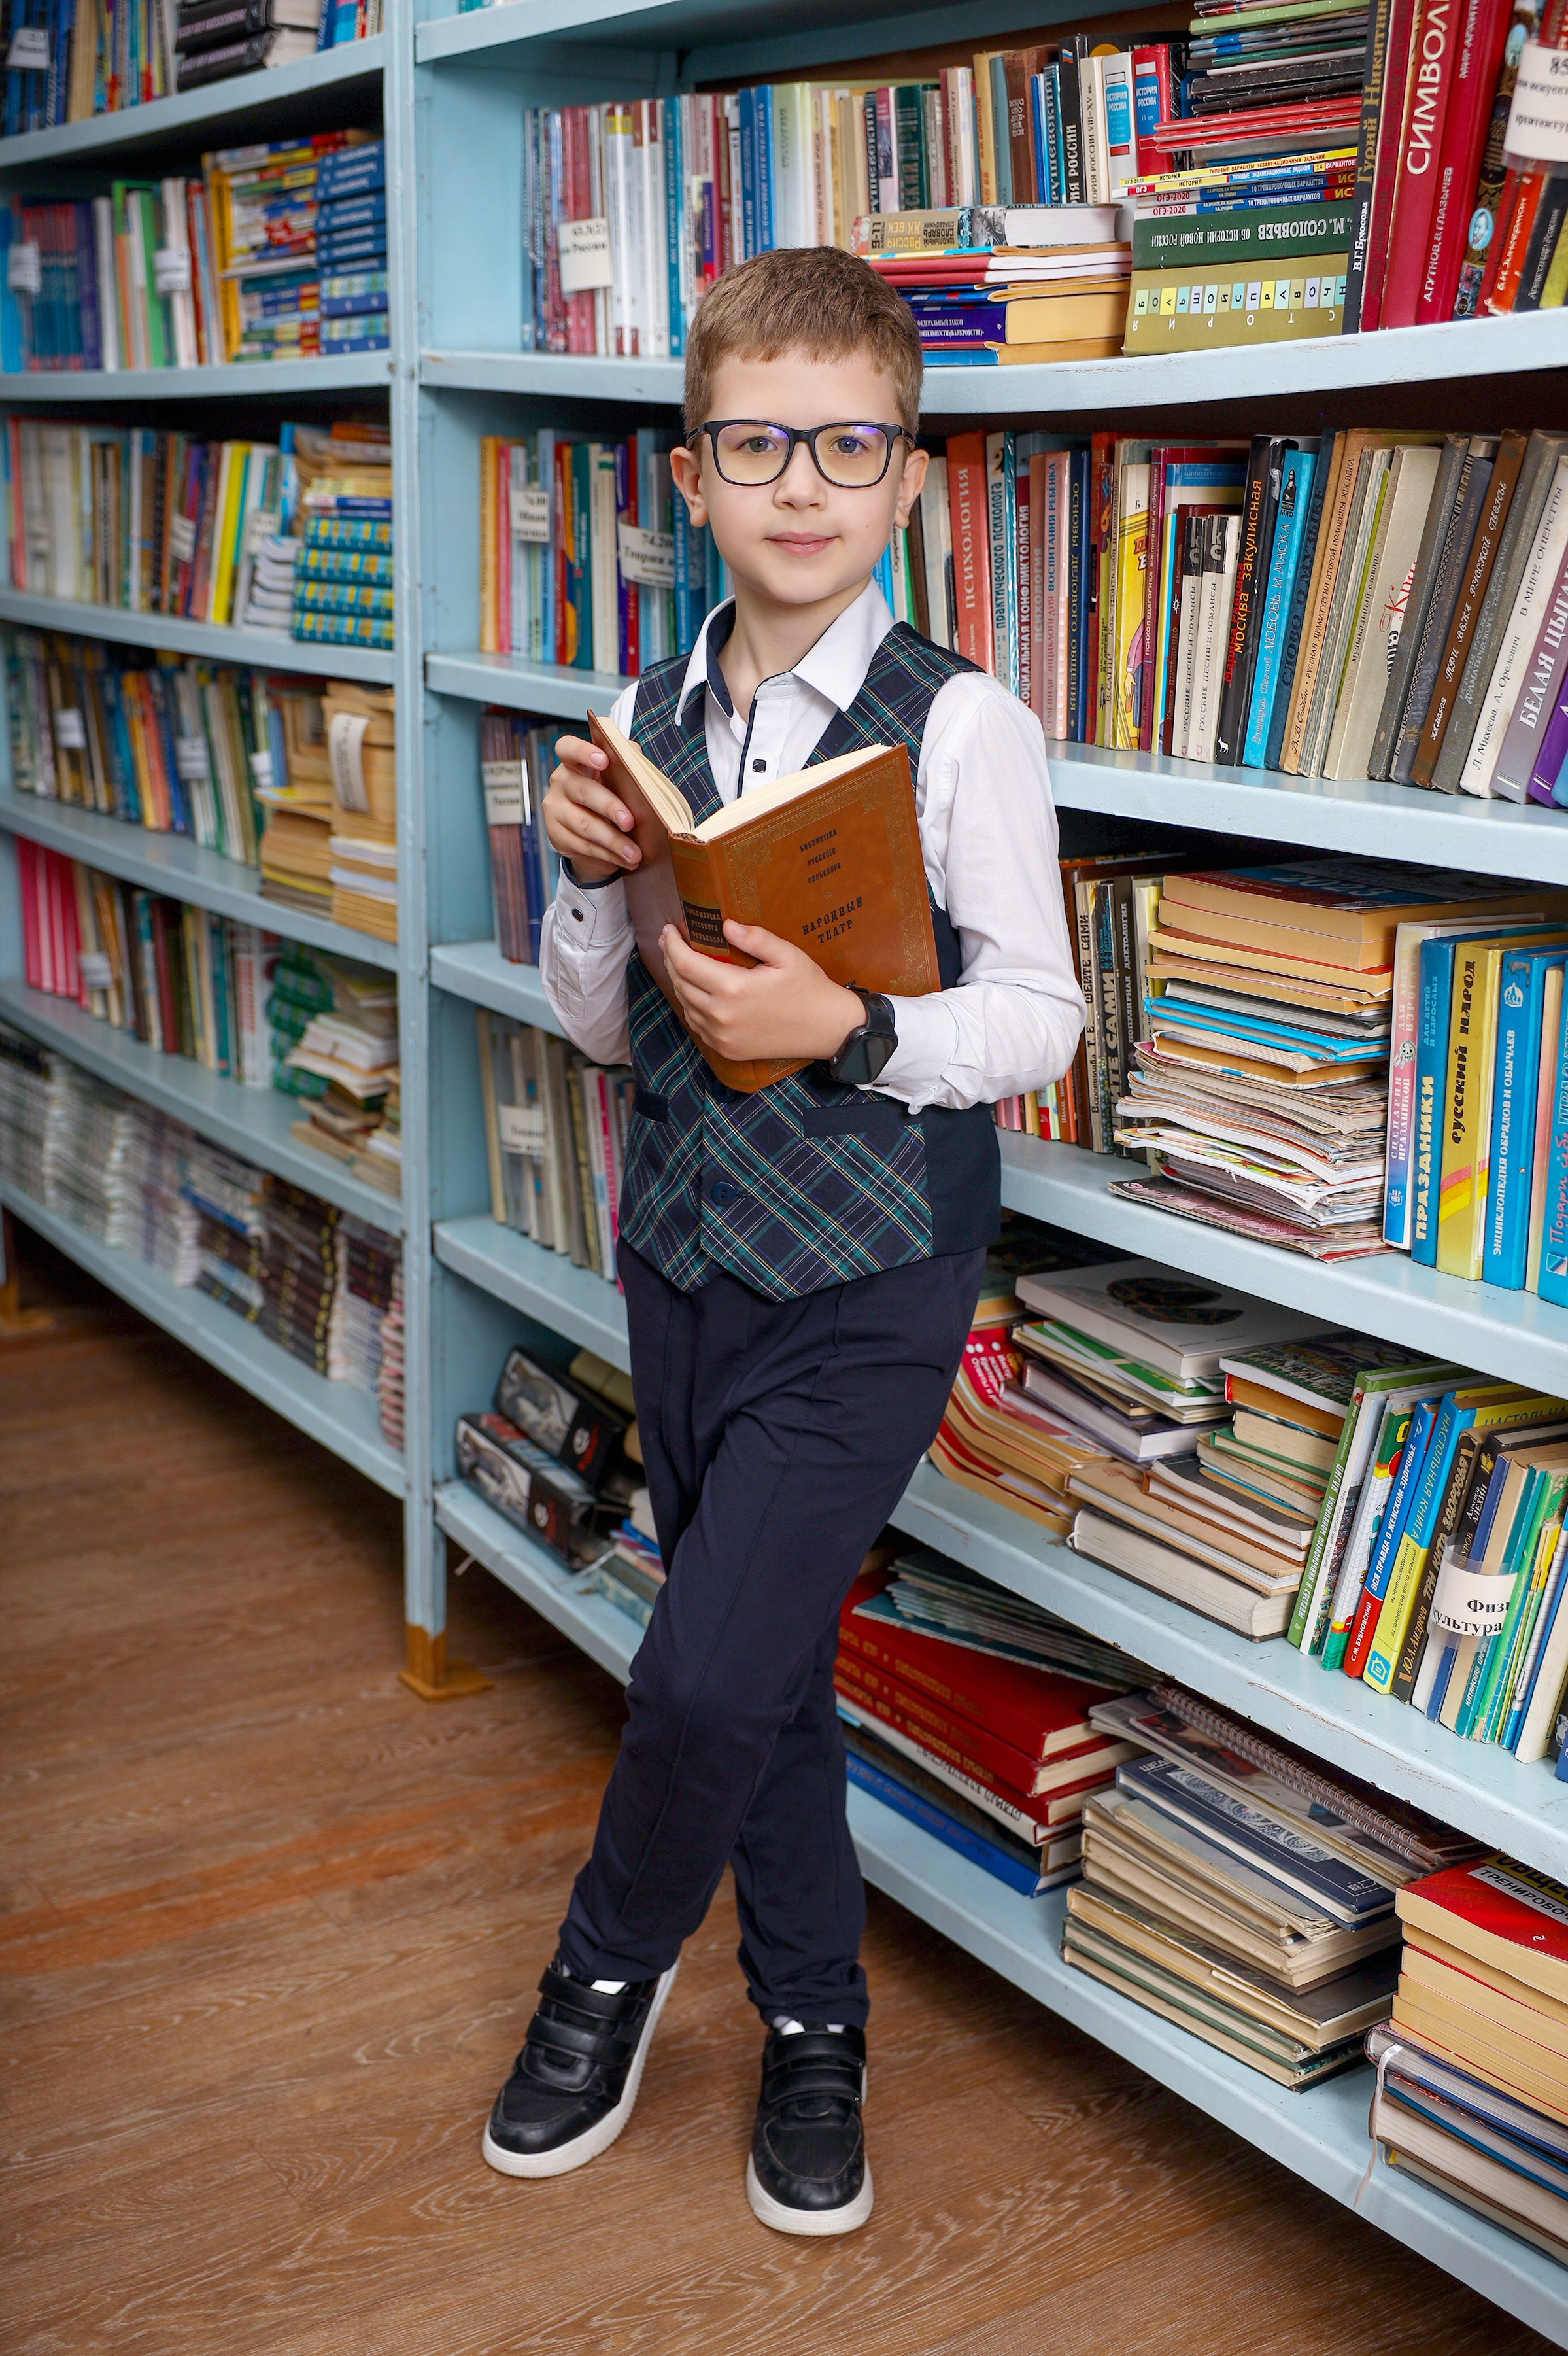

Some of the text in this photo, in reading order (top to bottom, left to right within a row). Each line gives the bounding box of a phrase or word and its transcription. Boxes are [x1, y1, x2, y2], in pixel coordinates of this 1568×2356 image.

[1106, 90, 1128, 102] ИСТОРИЯ
[1108, 101, 1127, 112] РОССИИ
[1135, 85, 1158, 97] ИСТОРИЯ
[1138, 96, 1157, 108] РОССИИ
[1065, 124, 1080, 179] РОССИИ
[1209, 165, 1231, 174] ТИПОВЫЕ
[1231, 163, 1255, 173] ВАРИАНТЫ
[1256, 159, 1302, 169] ЭКЗАМЕНАЦИОННЫХ
[1303, 154, 1326, 163] ЗАДАНИЙ
[1357, 116, 1378, 184] Гурий
[1156, 191, 1191, 203] ОГЭ-2020
[1257, 181, 1293, 193] ТРЕНИРОВОЧНЫХ
[1293, 178, 1324, 189] ВАРИАНТОВ
[1178, 179, 1202, 188] ИСТОРИЯ
[1231, 172, 1250, 181] ТИПОВЫЕ
[1252, 167, 1292, 179] ЭКЗАМЕНАЦИОННЫЕ
[1292, 165, 1311, 175] ЗАДАНИЯ
[1325, 159, 1355, 169] ВАРИАНТОВ
[887, 220, 906, 234] ВЕК
[1152, 205, 1187, 217] ОГЭ-2020
[1253, 196, 1293, 207] ТРЕНИРОВОЧНЫХ
[1293, 192, 1321, 202] ВАРИАНТОВ
[923, 228, 955, 237] СЛОВАРЬ
[923, 237, 955, 247] ШКОЛЬНЫЙ
[1151, 233, 1178, 249] РОССИИ
[1179, 230, 1204, 249] НОВОЙ
[1206, 228, 1239, 244] ИСТОРИИ
[1241, 228, 1250, 241] ОБ
[1257, 220, 1328, 241] СОЛОВЬЕВ
[1352, 201, 1369, 272] В.Г.Брюсова
[1048, 462, 1056, 511] РЕБЁНКА
[1242, 480, 1263, 581] закулисная
[1280, 510, 1294, 518] МИФ
[957, 468, 976, 609] ПСИХОЛОГИЯ
[991, 481, 1006, 629] практического психолога
[1282, 486, 1324, 687] СЛОВО О МУЗЫКЕ
[1306, 458, 1355, 678] РУССКАЯ ДРАМАТУРГИЯ ВТОРОЙ ПОЛОВИНЫ ВЕКА
[1444, 481, 1507, 682] ТРИ ВЕКА РУССКОЙ СЦЕНЫ
[1018, 504, 1031, 706] СОЦИАЛЬНАЯ КОНФЛИКТОЛОГИЯ
[1034, 547, 1043, 643] ПСИХОЛОГИЯ
[1145, 571, 1153, 656] ПСИХОПЕДАГОГИКА
[1207, 582, 1216, 632] РОМАНСЫ
[1352, 553, 1380, 663] музыкальный словарь
[1047, 595, 1057, 677] ЭНЦИКЛОПЕДИЯ
[1206, 635, 1212, 644] И
[1252, 523, 1291, 746] Дмитрий Щеглов ЛЮБОВЬ И МАСКА
[1464, 571, 1507, 704] ДРАМАТИЧЕСКОГО ТЕАТРА
[1473, 600, 1491, 651] РУССКОГО
[1473, 487, 1563, 771] Л. Михеева, А. Орелович В МИРЕ ОПЕРЕТТЫ
[1069, 638, 1078, 711] ОБЩЕНИЯ
[1169, 627, 1178, 686] ШУЛЬЖЕНКО
[1183, 687, 1191, 733] РУССКИЕ
[1188, 585, 1199, 635] РОМАНСЫ
[1224, 629, 1238, 687] Марина
[1106, 693, 1112, 702] В.
[1199, 685, 1208, 731] РУССКИЕ
[1518, 651, 1556, 730] БЕЛАЯ
[799, 829, 838, 854] БИБЛИОТЕКА
[807, 847, 837, 867] РУССКОГО
[806, 862, 842, 884] ФОЛЬКЛОРА
[685, 906, 721, 922] БИБЛИОТЕКА
[690, 919, 719, 932] РУССКОГО
[802, 896, 864, 936] НАРОДНЫЙ
[817, 919, 854, 944] ТЕАТР
[691, 931, 724, 944] ФОЛЬКЛОРА
[1079, 914, 1096, 1047] Т. ШЕЙТЕ САМИ
[1120, 903, 1134, 1043] ПОПУЛЯРНАЯ ДИЕТОЛОГИЯ
[1103, 979, 1118, 1050] САМИ
[1429, 975, 1439, 1047] И ВЗРОСЛЫХ
[1451, 960, 1476, 1145] РУССКИЙ НАРОД
[1390, 1076, 1402, 1160] СЦЕНАРИИ
[1397, 1077, 1411, 1161] ПРАЗДНИКОВ
[1415, 1075, 1435, 1241] ПРАЗДНИКИ
[1493, 1029, 1516, 1256] ЭНЦИКЛОПЕДИЯ ОБРЯДОВ И ОБЫЧАЕВ
[1331, 1463, 1344, 1494] ЦИГУН
[1399, 1443, 1417, 1488] ЗДОРОВЬЕ
[1410, 1413, 1451, 1540] НАСТОЛЬНАЯ КНИГА
[1330, 1504, 1342, 1544] ОЛИМПИЙСКИЙ
[1388, 1489, 1405, 1530] ЖЕНСКОМ
[1466, 1485, 1480, 1520] Александр
[1471, 1483, 1488, 1526] АЛЕХИН
[1323, 1546, 1332, 1568] УЧЕБНИК
[1375, 1542, 1390, 1574] ПРАВДА
[1386, 1531, 1393, 1540] О
[1371, 1574, 1381, 1592] ВСЯ
[1391, 1542, 1410, 1604] жизнедеятельности
[1401, 1455, 1469, 1675] Ю.А.Андреев ТРИ ЗДОРОВЬЯ
[1408, 1548, 1417, 1575] учителя
[1355, 1601, 1372, 1646] БУБНОВСКИЙ
[1391, 1595, 1407, 1637] безопасности
[1431, 1606, 1503, 1637] культура
[1354, 1646, 1361, 1654] М.
[1464, 1661, 1482, 1708] КИТАЙСКАЯ
